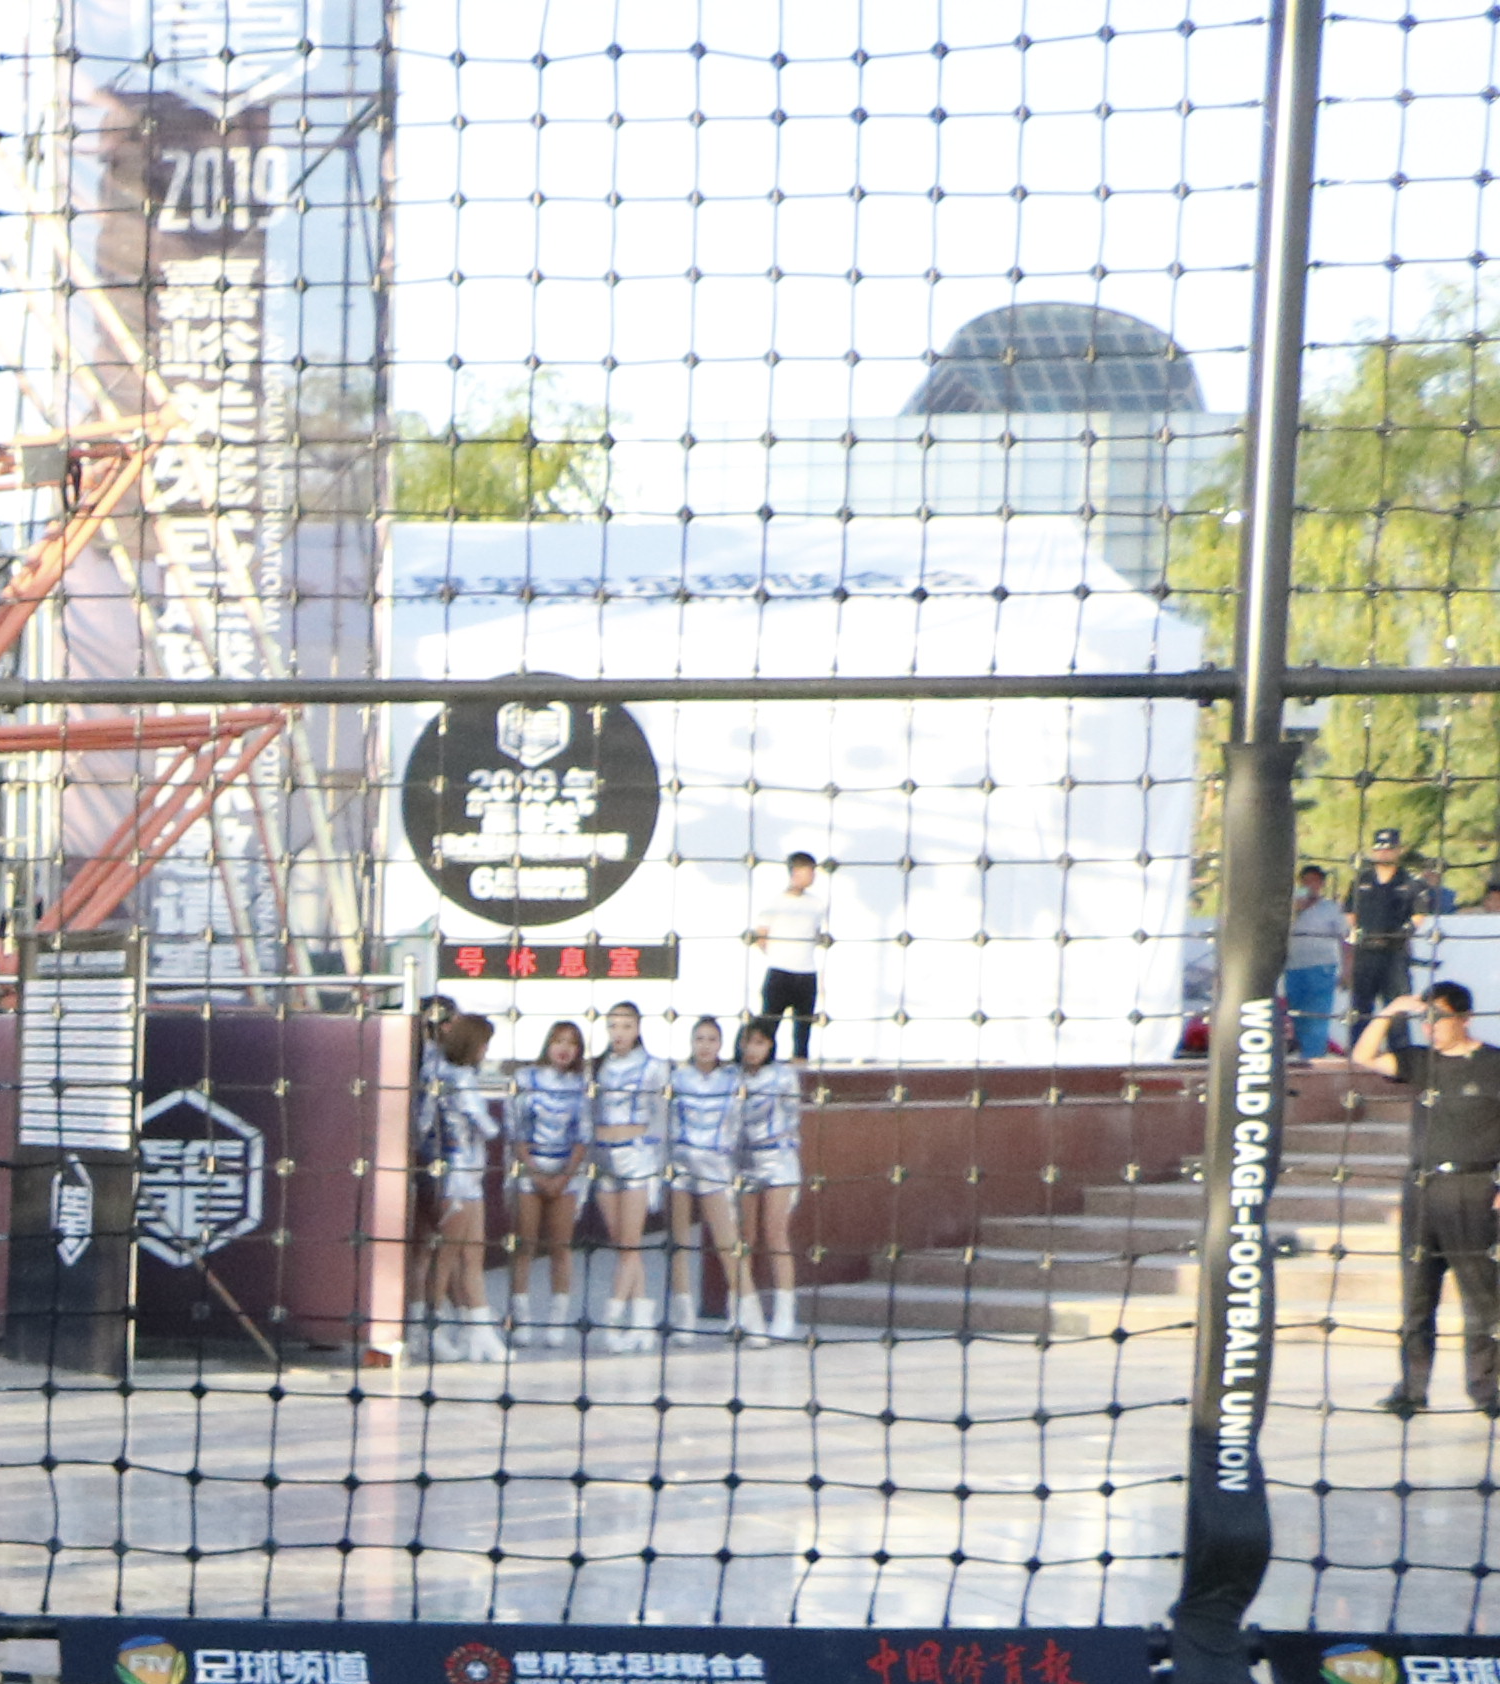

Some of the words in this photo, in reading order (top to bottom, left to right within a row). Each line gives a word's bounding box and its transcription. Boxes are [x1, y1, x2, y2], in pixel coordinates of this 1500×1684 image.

[157, 146, 290, 232] 2019
[455, 946, 641, 977] 号休息室
[1235, 997, 1275, 1117] WORLD
[1222, 1119, 1270, 1388] CAGE-FOOTBALL
[1216, 1390, 1257, 1494] UNION
